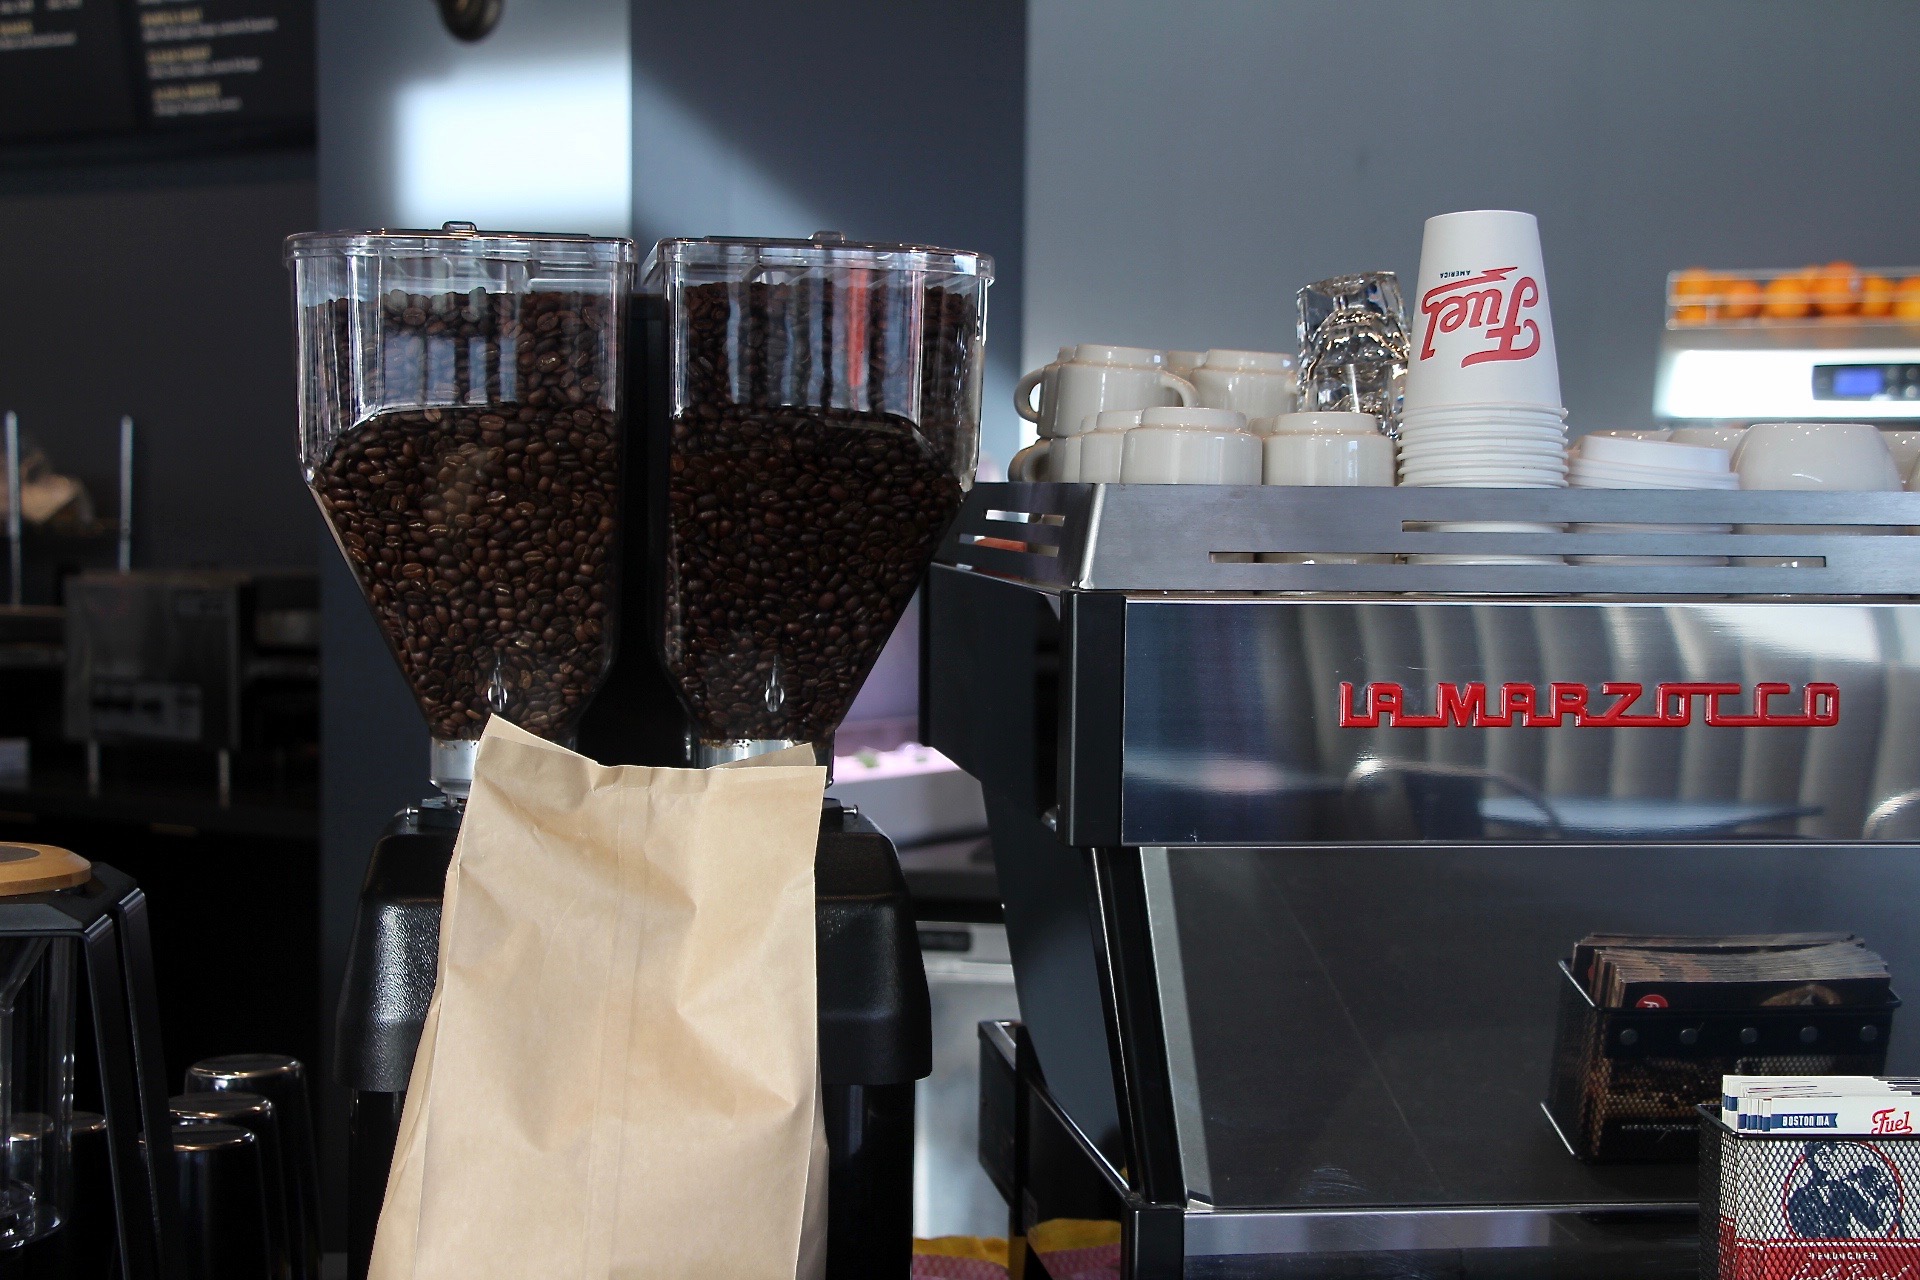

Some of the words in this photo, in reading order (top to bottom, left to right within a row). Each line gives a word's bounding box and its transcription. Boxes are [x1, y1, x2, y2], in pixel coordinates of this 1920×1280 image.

[1439, 270, 1471, 279] AMERICA
[1420, 266, 1541, 368] Fuel
[1339, 682, 1403, 728] LA
[1782, 1115, 1814, 1127] BOSTON
[1816, 1114, 1830, 1126] MA
[1871, 1107, 1913, 1134] Fuel
